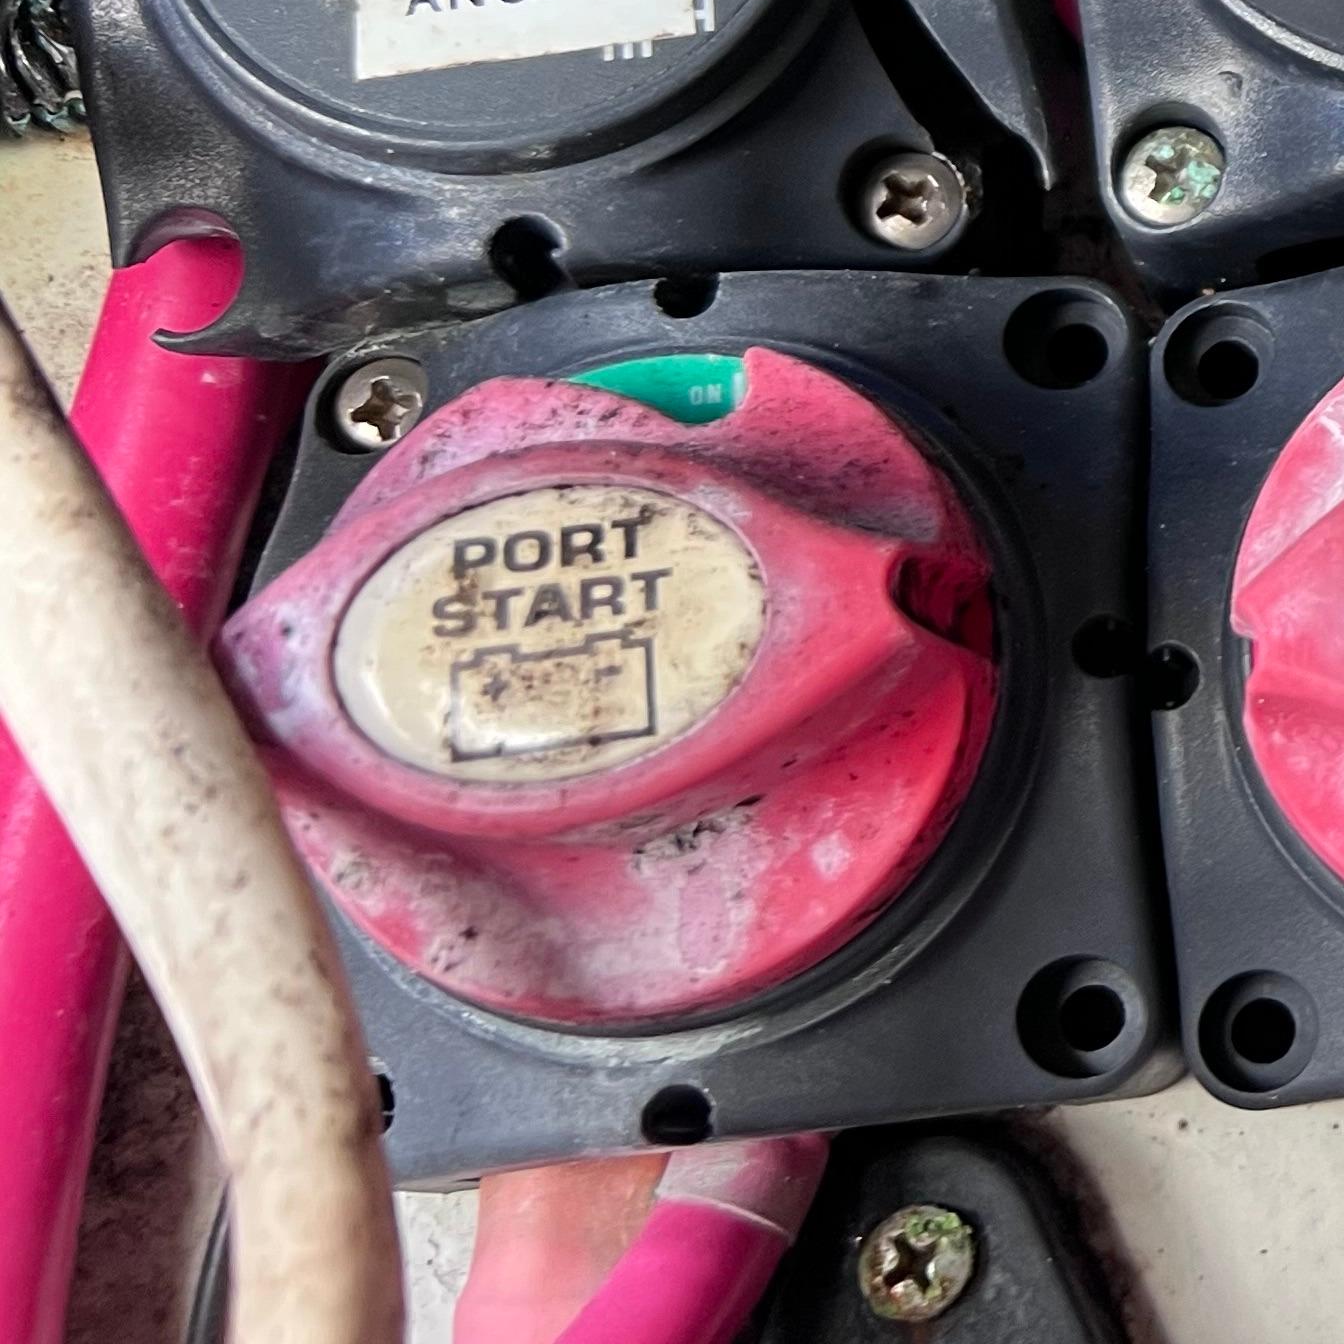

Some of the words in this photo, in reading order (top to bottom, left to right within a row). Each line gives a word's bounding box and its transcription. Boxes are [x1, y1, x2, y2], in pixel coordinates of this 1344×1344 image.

[689, 382, 723, 406] ON
[452, 517, 648, 579] PORT
[431, 567, 674, 639] START
